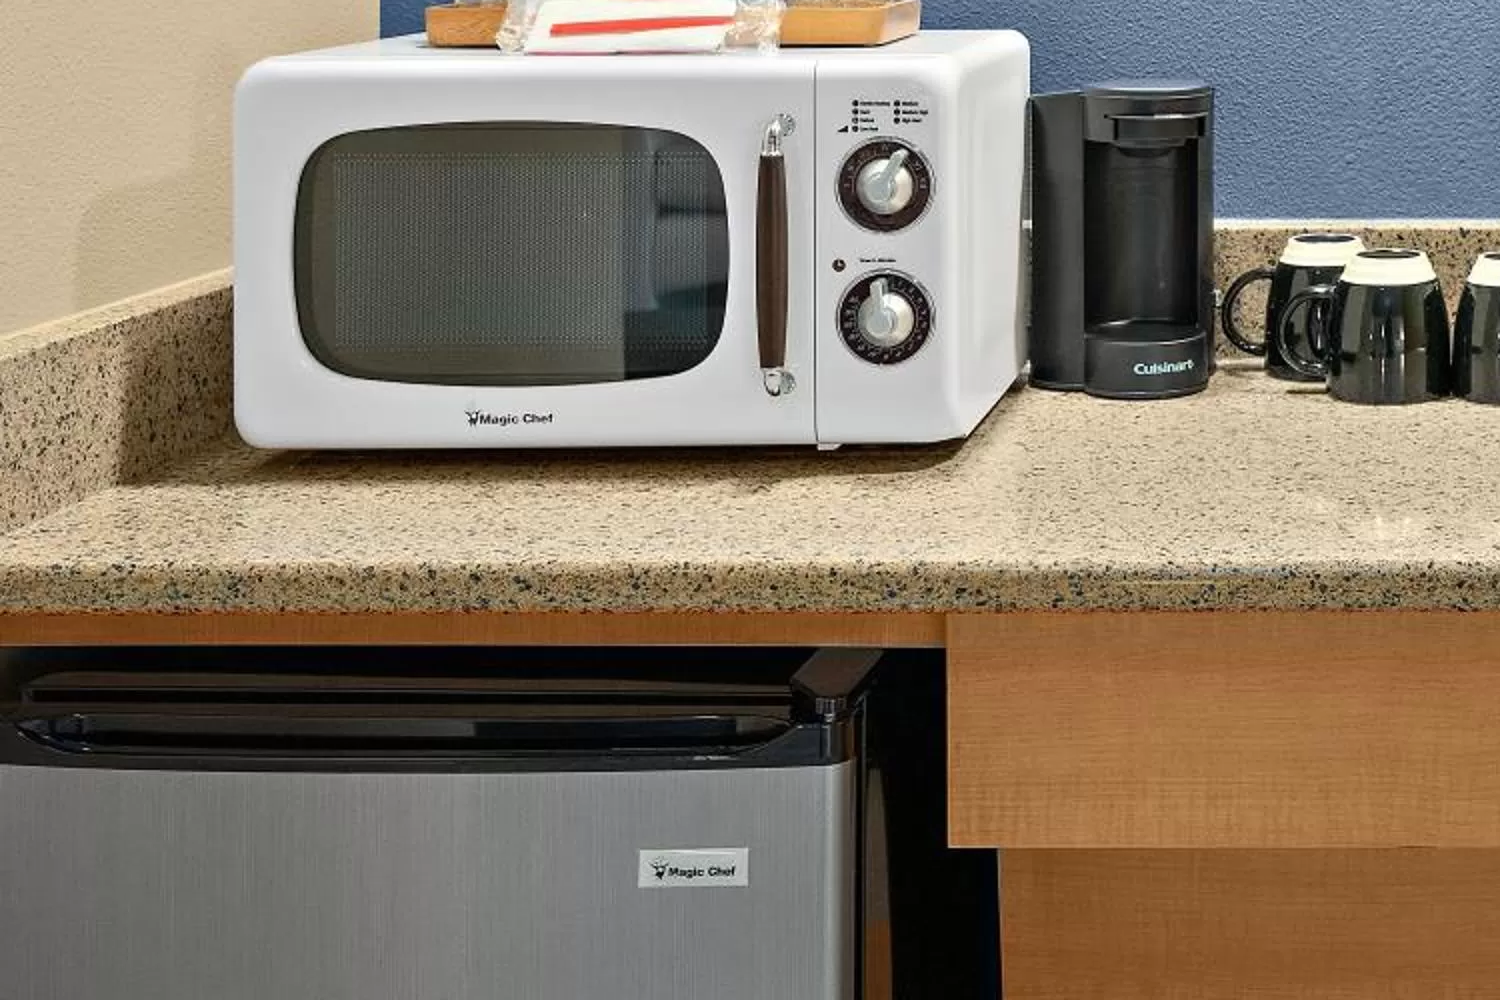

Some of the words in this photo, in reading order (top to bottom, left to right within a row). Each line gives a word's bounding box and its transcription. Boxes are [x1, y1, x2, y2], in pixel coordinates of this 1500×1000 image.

[1133, 359, 1194, 375] Cuisinart
[479, 413, 518, 426] Magic
[523, 413, 553, 424] Chef
[668, 866, 705, 879] Magic
[707, 865, 736, 877] Chef
